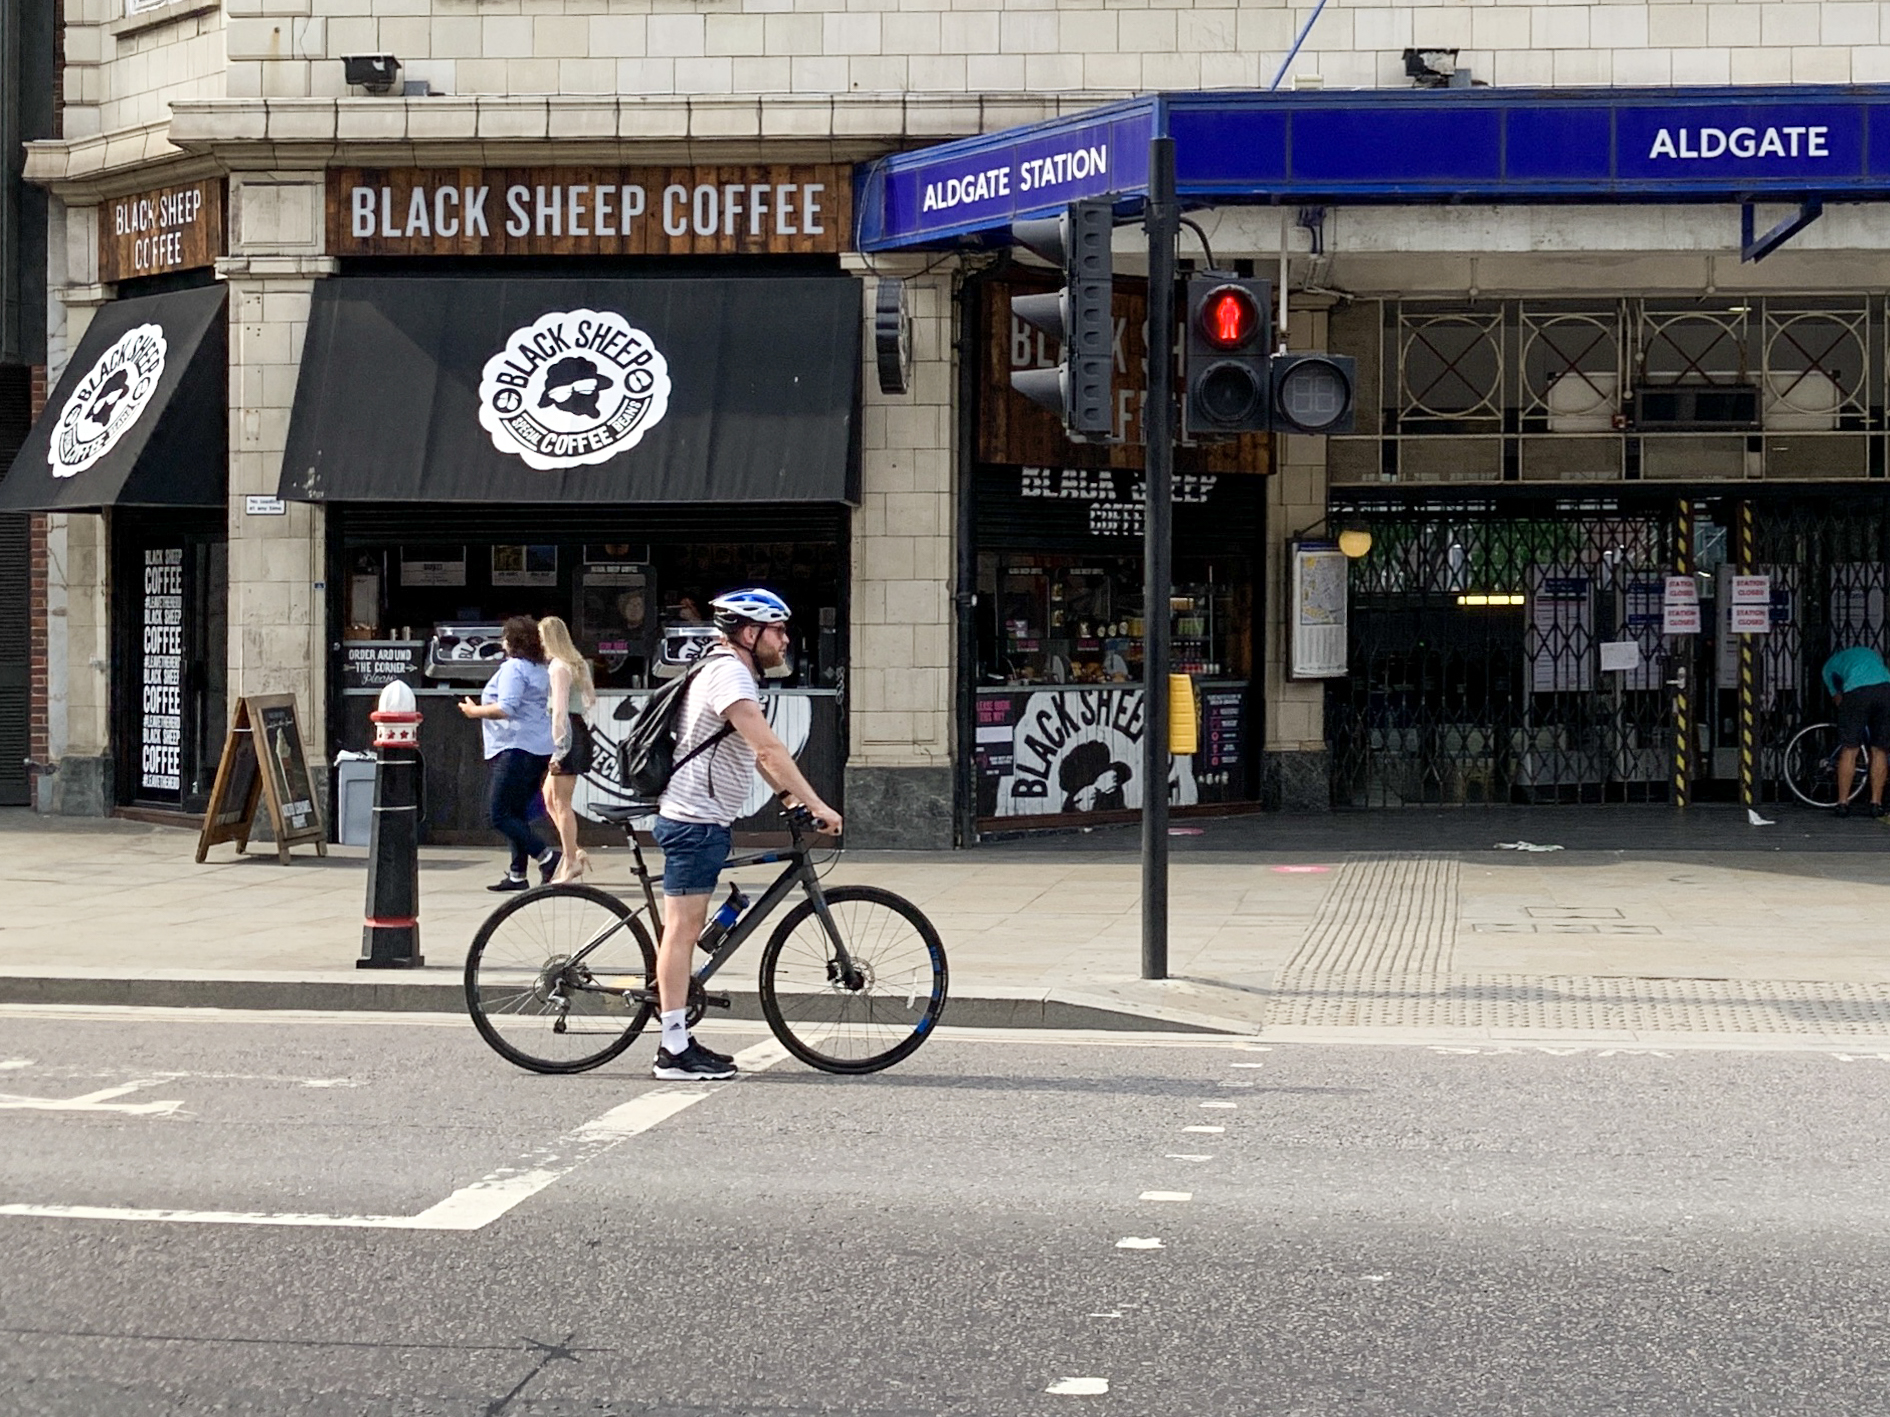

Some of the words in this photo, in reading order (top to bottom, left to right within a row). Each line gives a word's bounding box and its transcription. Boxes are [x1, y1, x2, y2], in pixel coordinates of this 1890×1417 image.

[1650, 126, 1829, 159] ALDGATE
[923, 167, 1011, 212] ALDGATE
[1020, 145, 1107, 191] STATION
[116, 198, 157, 235] BLACK
[160, 189, 201, 227] SHEEP
[351, 185, 489, 238] BLACK
[506, 184, 645, 237] SHEEP
[662, 184, 825, 236] COFFEE
[135, 232, 181, 269] COFFEE
[496, 323, 571, 388] BLACK
[575, 320, 653, 370] SHEEP
[1012, 316, 1127, 374] BLK
[78, 338, 131, 401] BLACK
[127, 335, 160, 378] SHEEP
[511, 417, 543, 445] SPECIAL
[540, 425, 613, 455] COFFEE
[611, 400, 641, 432] BEANS
[1089, 502, 1146, 536] COFFE
[145, 566, 182, 594] COFFEE
[144, 609, 162, 625] BLACK
[144, 626, 181, 654] COFFEE
[349, 649, 376, 660] ORDER
[377, 649, 412, 660] AROUND
[144, 668, 162, 684] BLACK
[355, 662, 372, 673] THE
[374, 662, 406, 673] CORNER
[143, 685, 180, 714] COFFEE
[143, 728, 161, 744] BLACK
[1011, 690, 1082, 797] BLACK
[1080, 690, 1144, 744] SHEE
[142, 745, 180, 775] COFFEE
